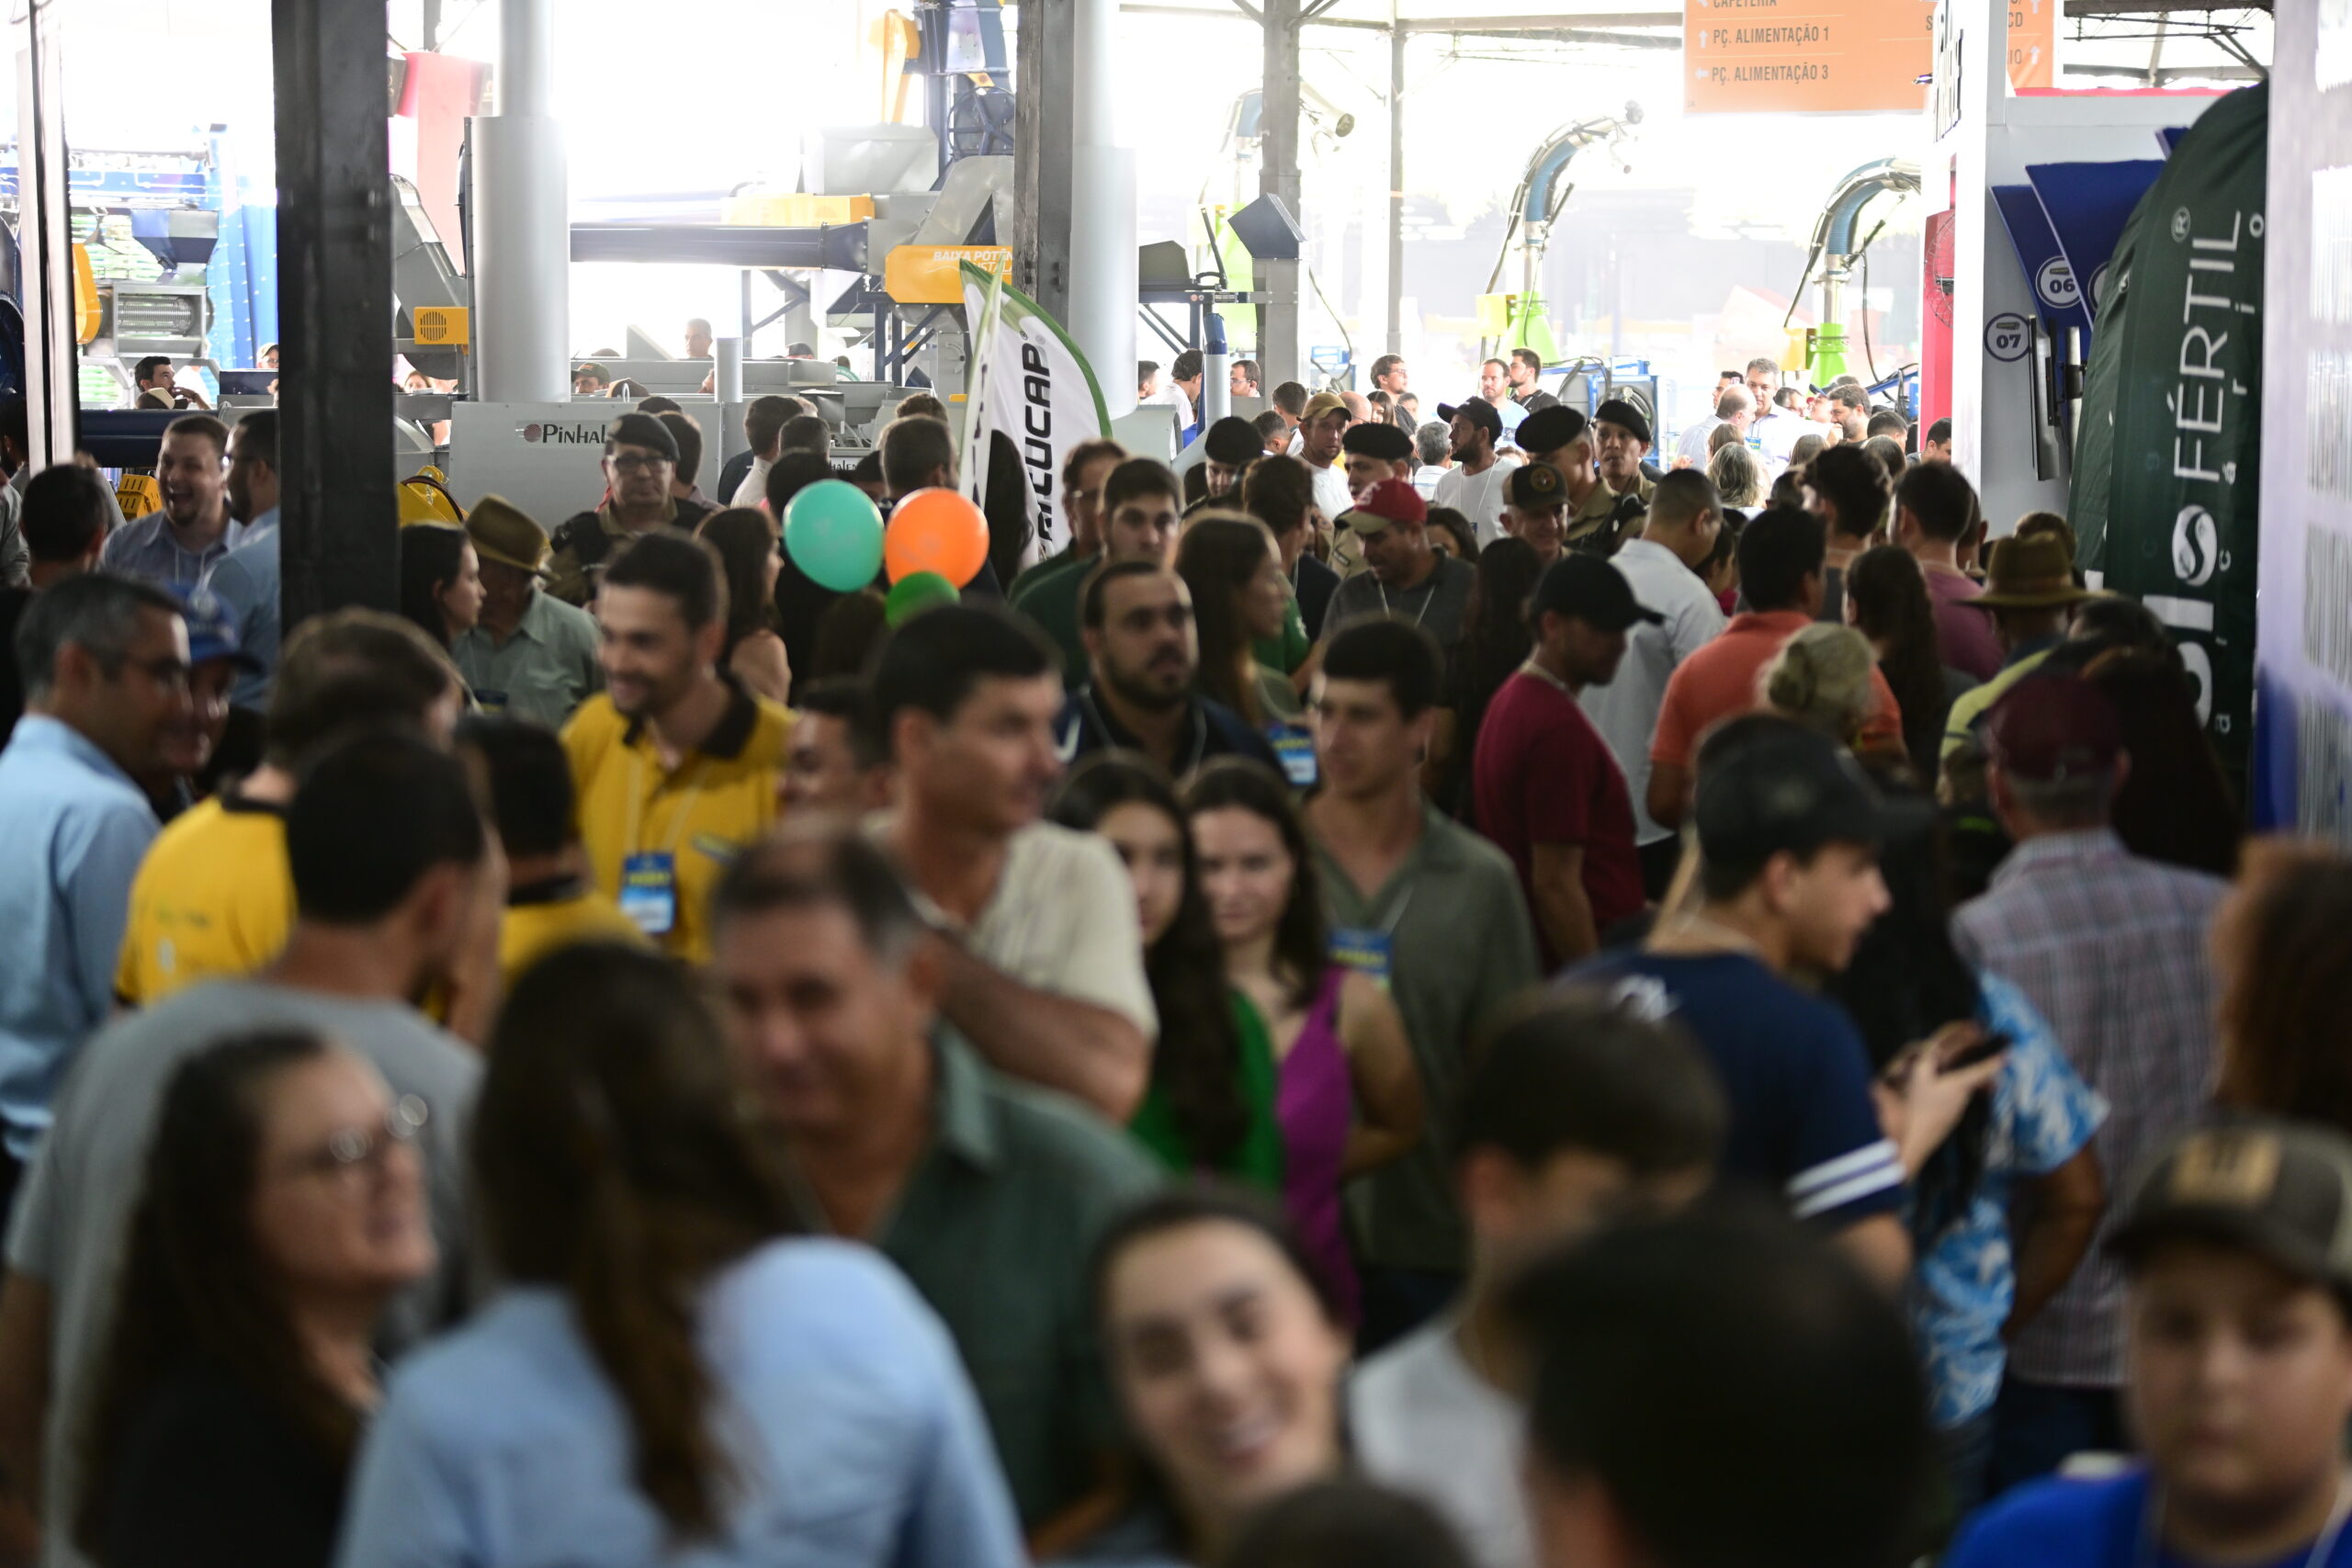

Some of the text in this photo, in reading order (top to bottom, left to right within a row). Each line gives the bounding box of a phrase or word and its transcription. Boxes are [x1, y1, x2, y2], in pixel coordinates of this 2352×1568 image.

[1736, 23, 1819, 46] ALIMENTAÇÃO
[1823, 26, 1829, 41] 1
[1734, 62, 1818, 85] ALIMENTAÇÃO
[1822, 64, 1828, 80] 3
[933, 251, 971, 261] BAIXA
[2050, 278, 2076, 294] 06
[1996, 333, 2021, 349] 07
